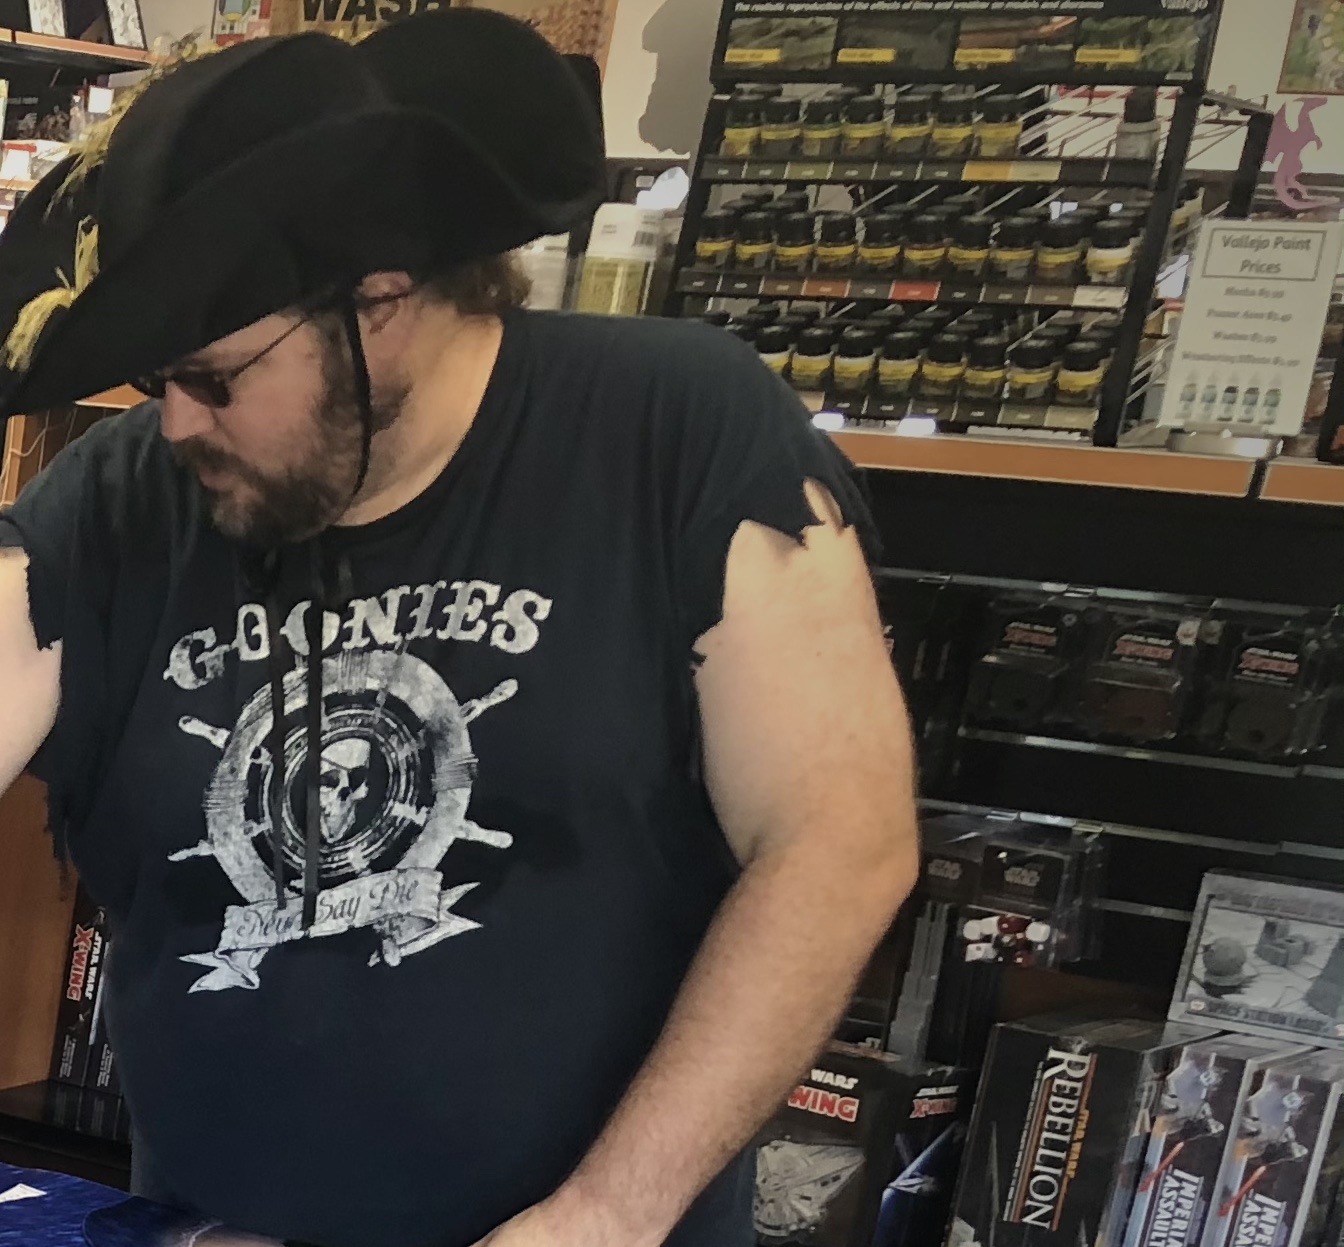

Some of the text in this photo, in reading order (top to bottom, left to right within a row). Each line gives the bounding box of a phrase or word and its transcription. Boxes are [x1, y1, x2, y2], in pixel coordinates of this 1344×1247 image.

[1222, 235, 1312, 252] Vallejo Paint
[1238, 259, 1282, 274] Prices
[162, 579, 554, 691] GOONIES
[318, 892, 362, 920] Say
[84, 931, 103, 1001] STAR WARS
[811, 1068, 859, 1090] WARS
[787, 1085, 860, 1123] WING
[1020, 1046, 1093, 1231] REBELLION
